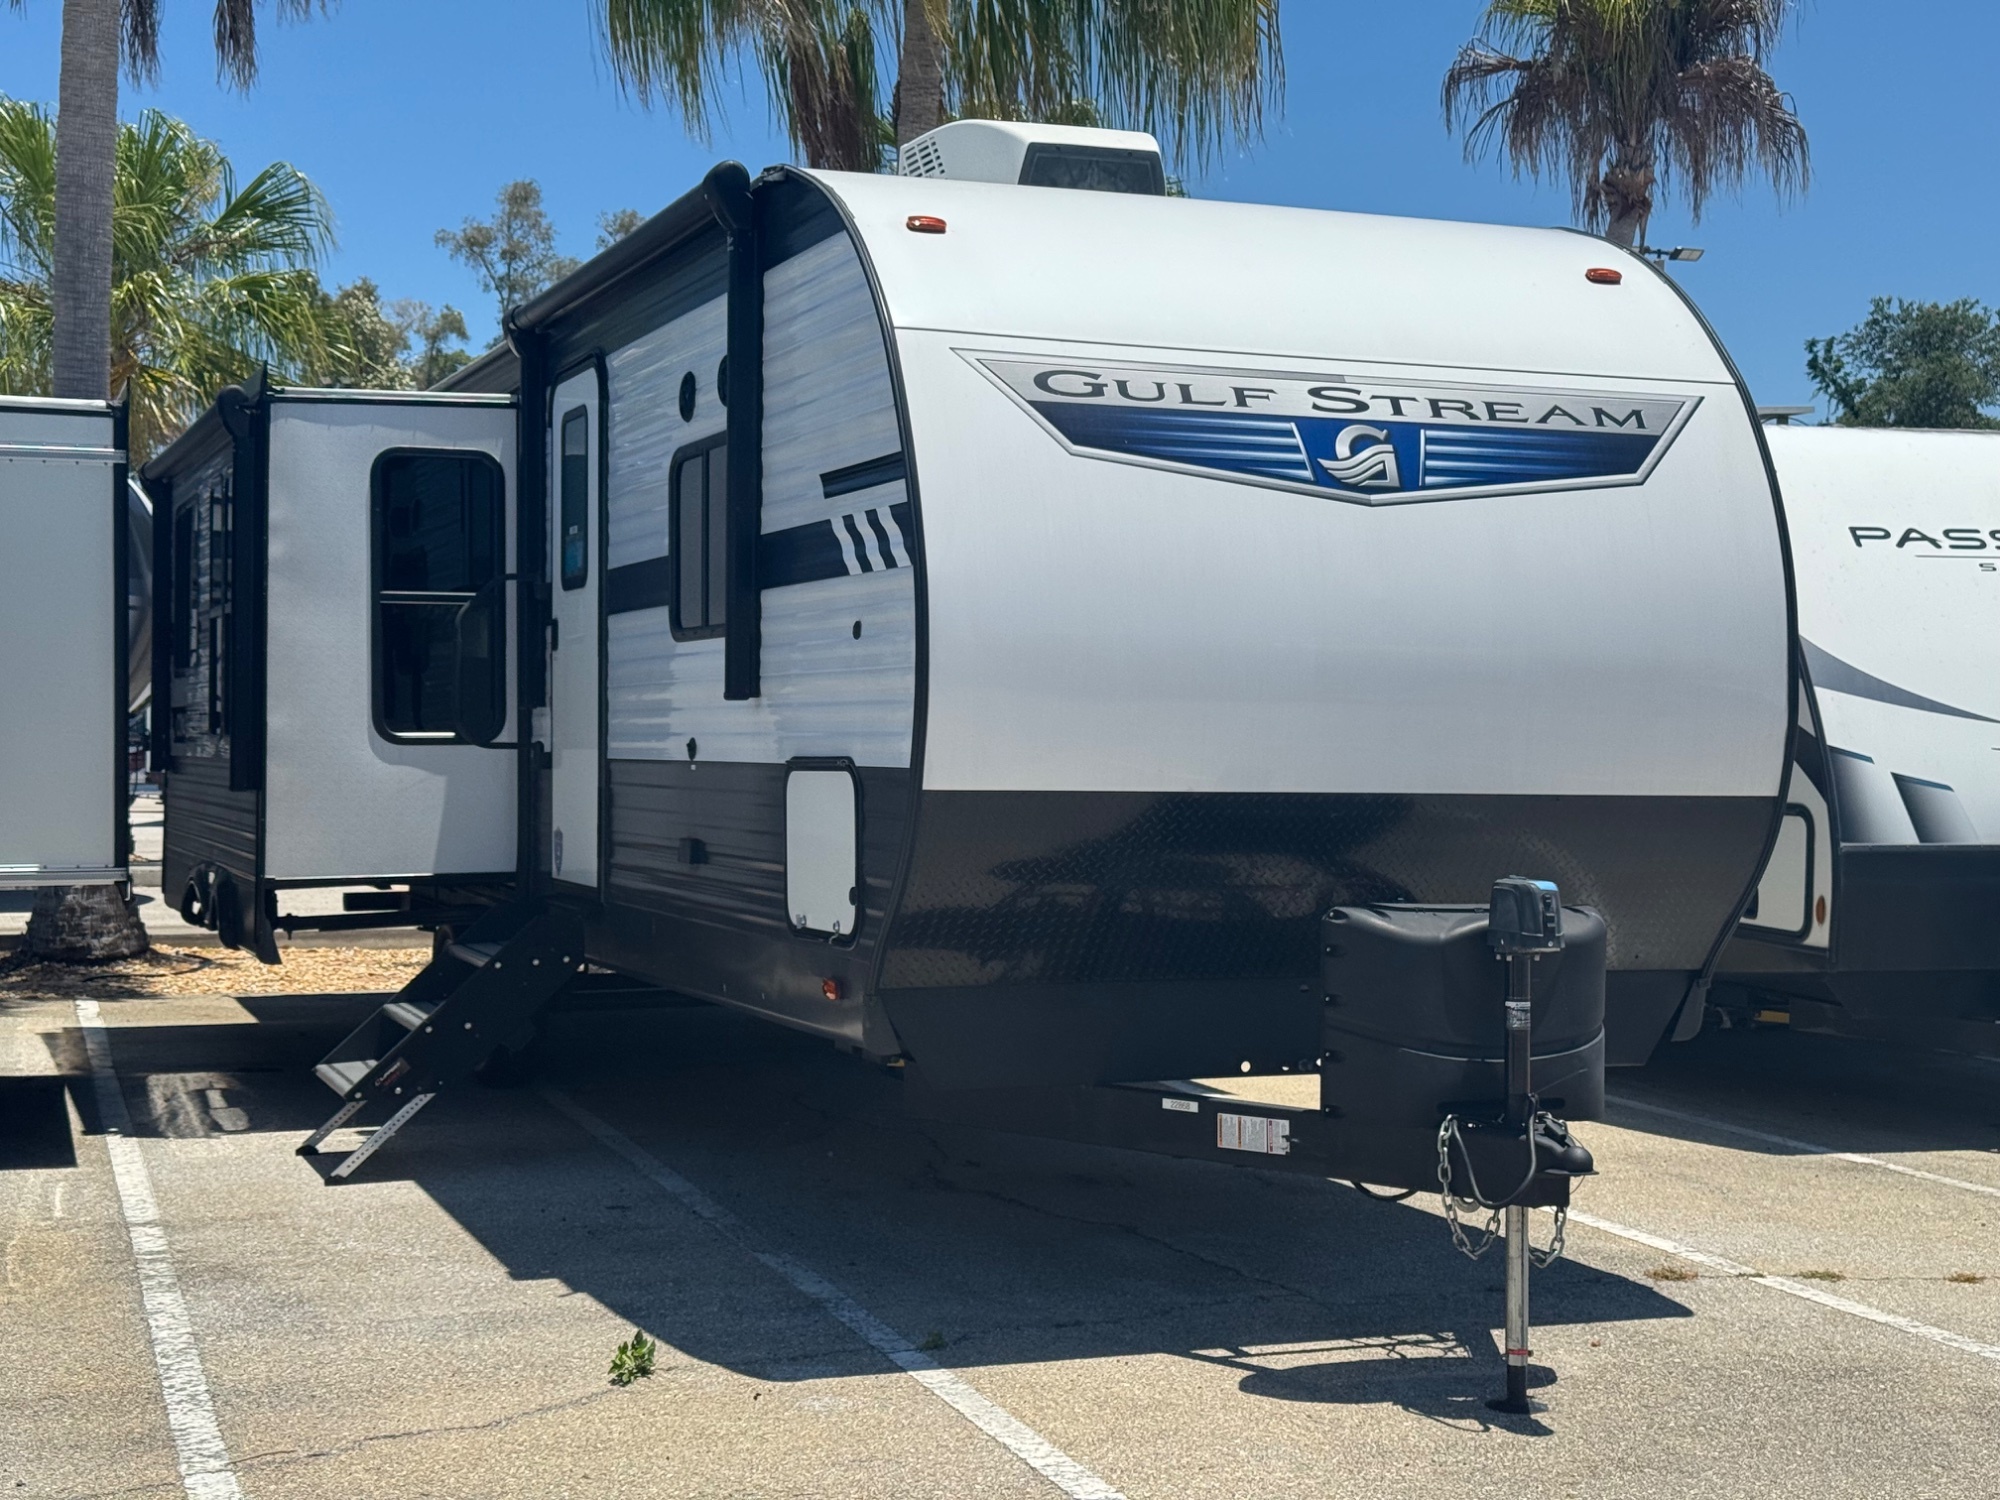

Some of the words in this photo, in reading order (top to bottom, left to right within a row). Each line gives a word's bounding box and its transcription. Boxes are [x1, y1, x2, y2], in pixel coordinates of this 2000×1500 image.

[1033, 369, 1279, 409] GULF
[1306, 386, 1649, 430] STREAM
[1848, 526, 2000, 550] PAS
